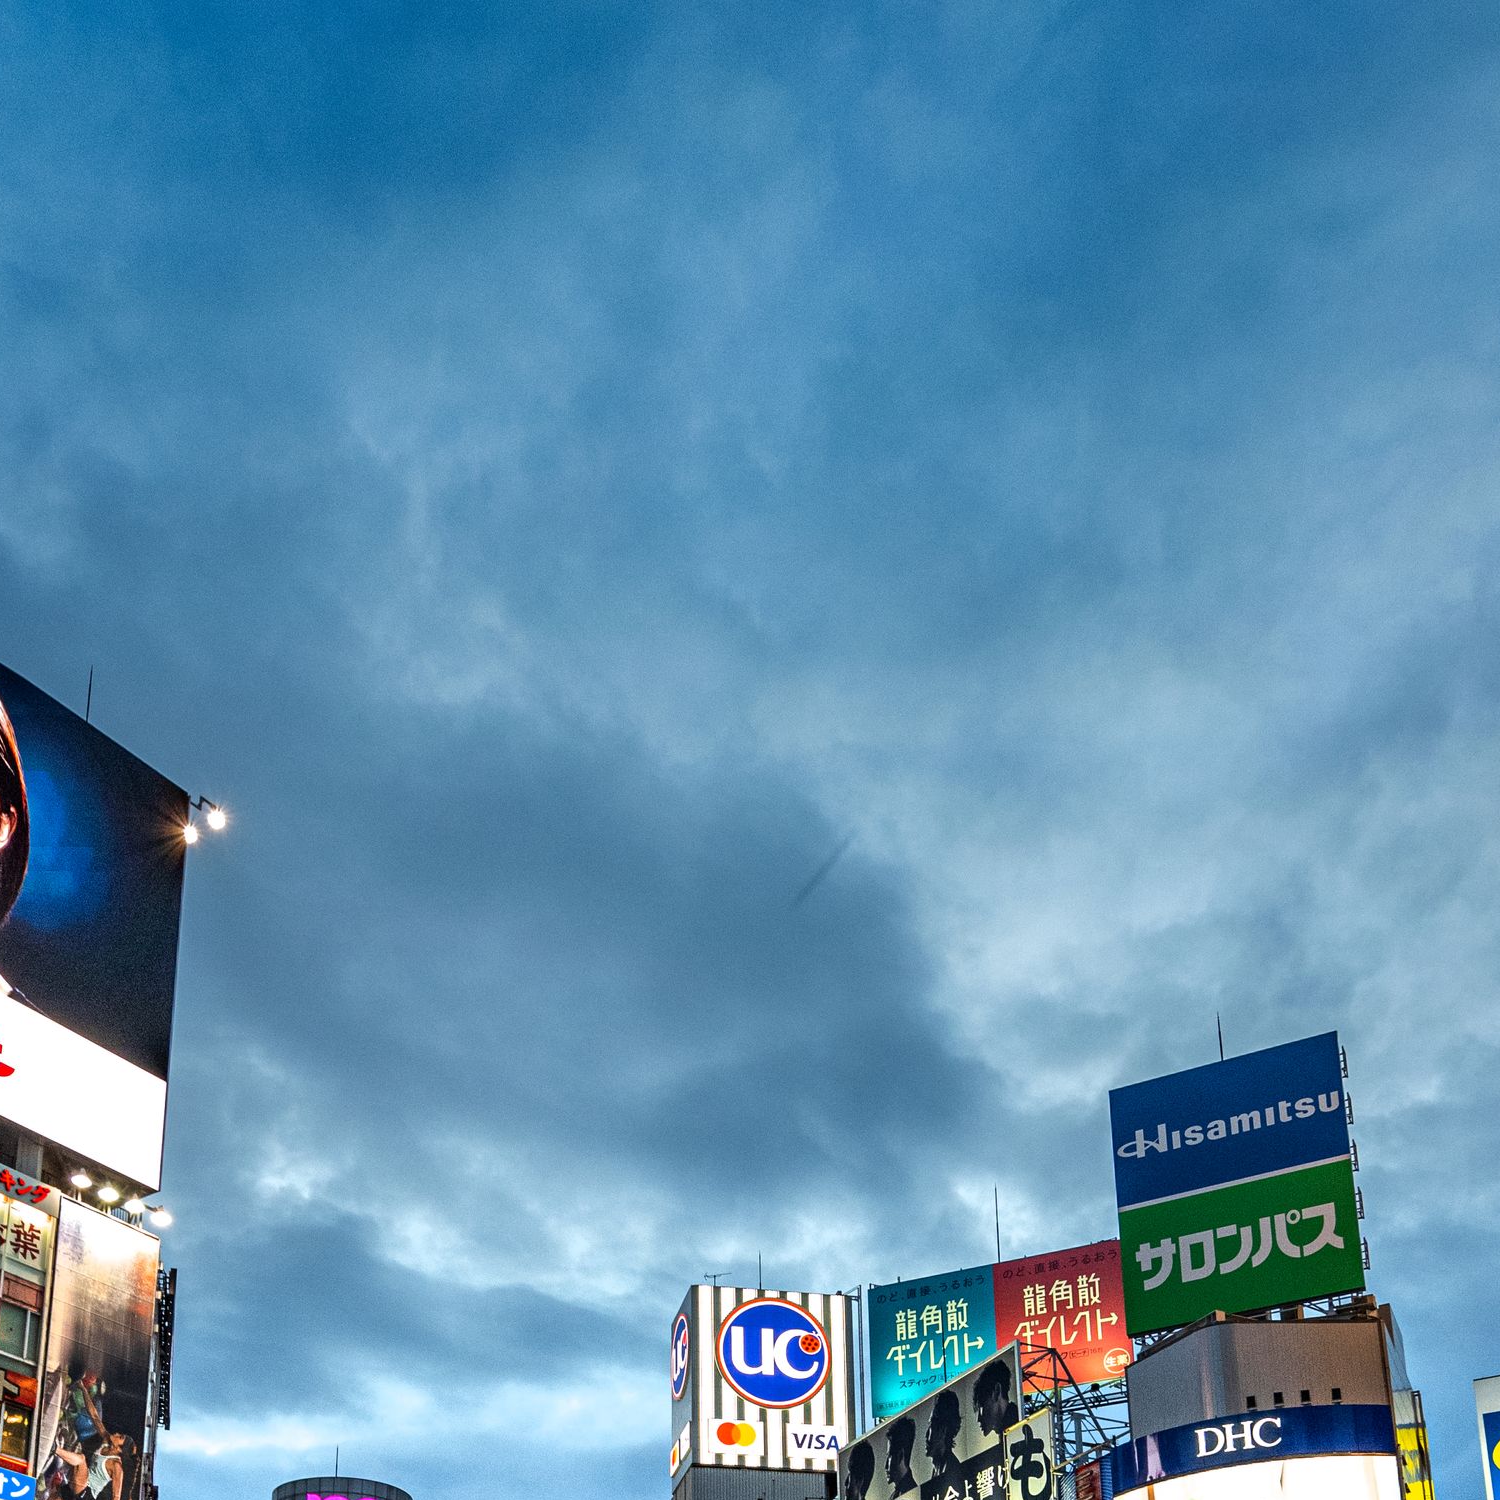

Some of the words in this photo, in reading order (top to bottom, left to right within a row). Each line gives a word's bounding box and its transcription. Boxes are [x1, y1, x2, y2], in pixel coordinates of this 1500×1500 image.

[1117, 1090, 1339, 1159] Hisamitsu
[1136, 1202, 1344, 1291] サロンパス
[1023, 1272, 1101, 1317] 龍角散
[895, 1298, 969, 1340] 龍角散
[1013, 1309, 1118, 1355] ダイレクト
[730, 1327, 819, 1379] UC
[886, 1334, 984, 1377] ダイレクト
[792, 1433, 840, 1450] VISA
[1194, 1417, 1282, 1458] DHC
